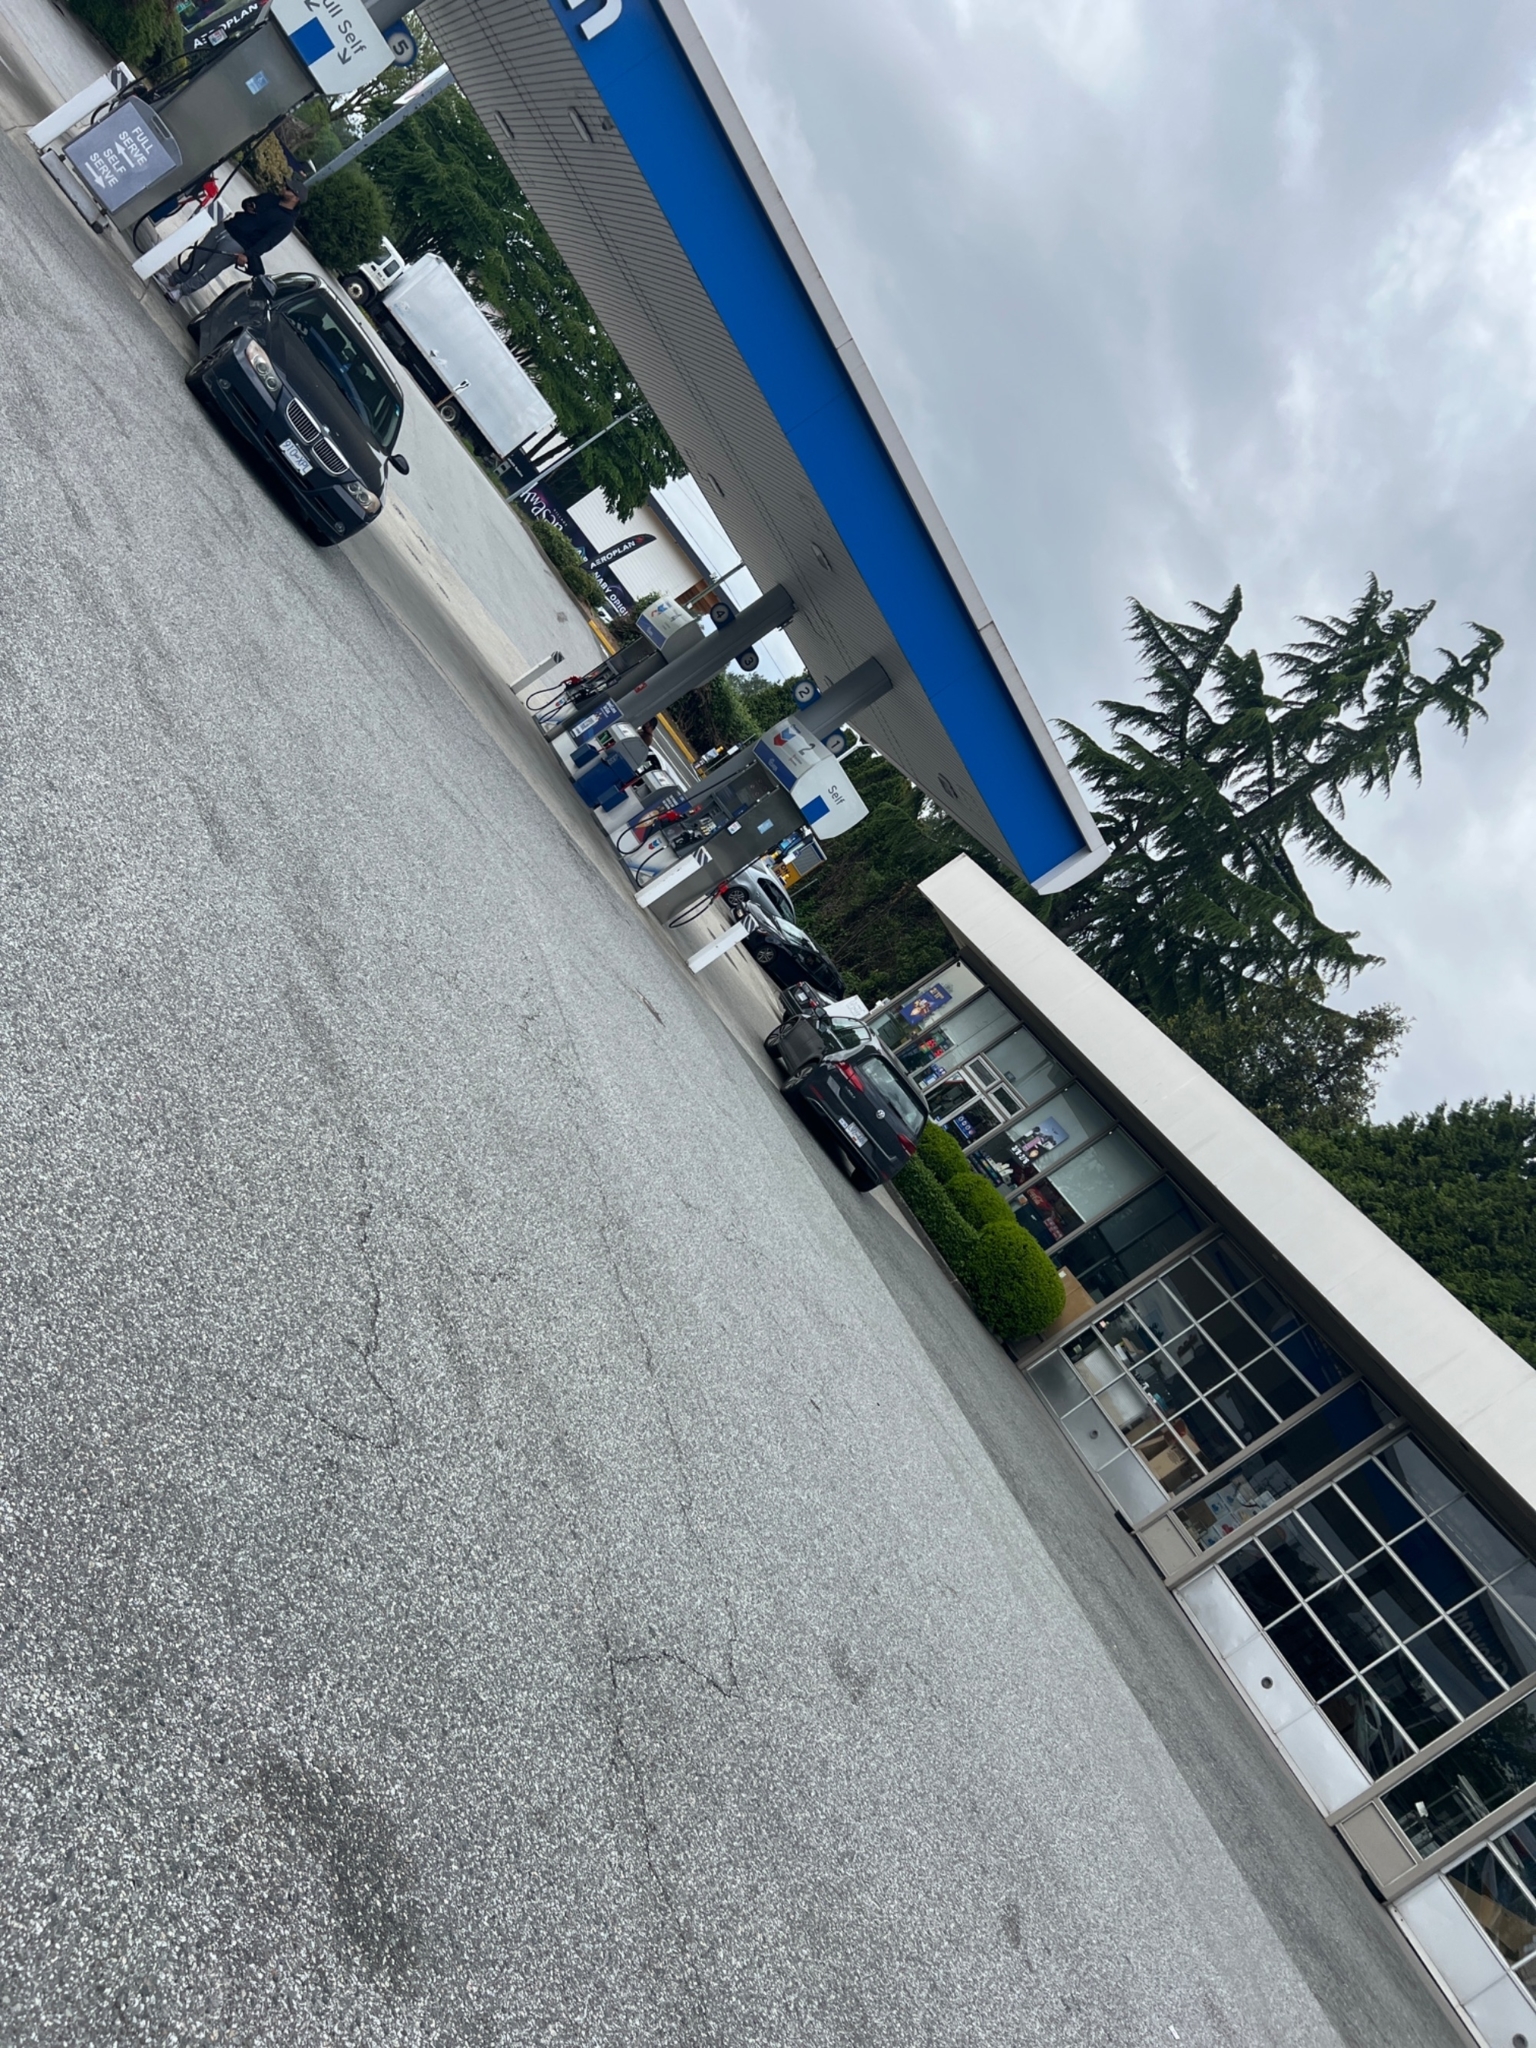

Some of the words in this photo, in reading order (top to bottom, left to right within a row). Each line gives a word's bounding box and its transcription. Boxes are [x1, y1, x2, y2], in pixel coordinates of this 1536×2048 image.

[322, 0, 343, 18] ull
[337, 19, 367, 54] Self
[392, 39, 409, 56] 5
[118, 130, 148, 166] SERVE
[131, 126, 154, 155] FULL
[89, 152, 119, 187] SERVE
[103, 148, 127, 174] SELF
[590, 541, 636, 569] AEROPLAN
[716, 610, 725, 619] 4
[744, 656, 754, 666] 3
[798, 686, 810, 699] 2
[798, 743, 816, 756] 2
[831, 740, 840, 749] 1
[827, 785, 845, 805] Self
